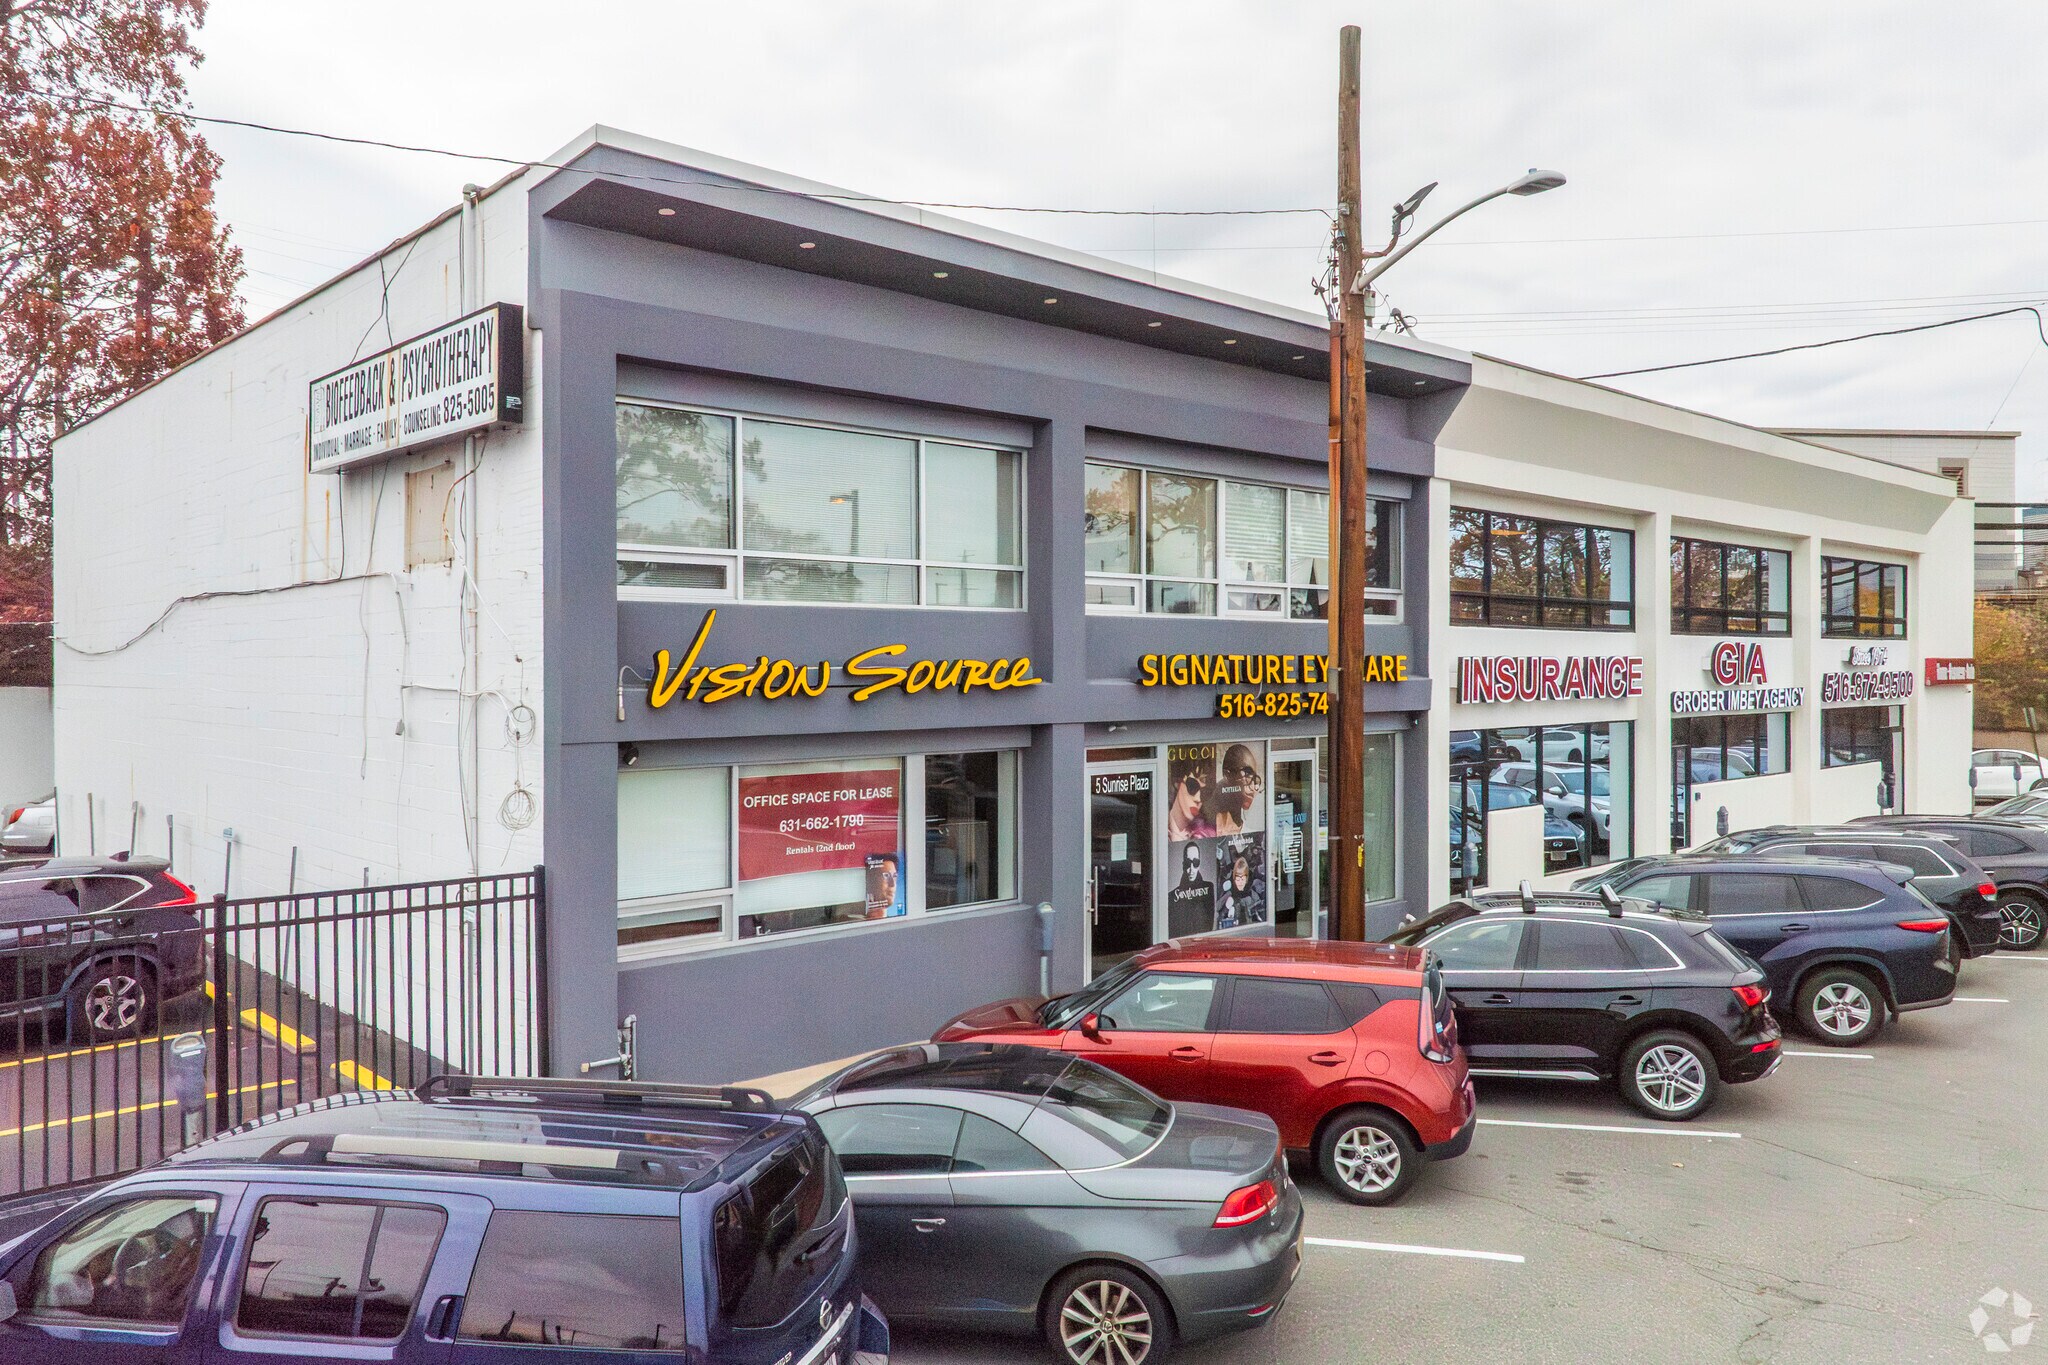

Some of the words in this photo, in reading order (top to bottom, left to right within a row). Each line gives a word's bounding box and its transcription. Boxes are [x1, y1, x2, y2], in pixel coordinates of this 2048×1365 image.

[325, 361, 385, 428] BIOFEEDBACK
[388, 357, 396, 406] &
[401, 316, 494, 402] PSYCHOTHERAPY
[344, 426, 372, 452] MARRIAGE
[376, 417, 398, 442] FAMILY
[403, 404, 441, 435] COUNSELING
[443, 382, 495, 424] 825-5005
[1140, 654, 1298, 687] SIGNATURE
[1302, 655, 1409, 684] EYARE
[1713, 641, 1768, 686] GIA
[1459, 656, 1644, 704] INSURANCE
[1824, 671, 1915, 703] 516-872-9500
[1219, 692, 1330, 719] 516-825-74
[1672, 690, 1725, 713] GROBER
[1727, 689, 1763, 711] IMBEY
[1763, 687, 1805, 709] AGENCY
[1168, 746, 1215, 761] GUCCI
[743, 794, 789, 808] OFFICE
[791, 791, 831, 805] SPACE
[833, 789, 857, 802] FOR
[859, 786, 893, 800] LEASE
[1095, 777, 1101, 794] 5
[1102, 775, 1130, 793] Sunrise
[1130, 774, 1149, 791] Plaza
[779, 814, 864, 832] 631-662-1790
[786, 845, 814, 855] Rentals
